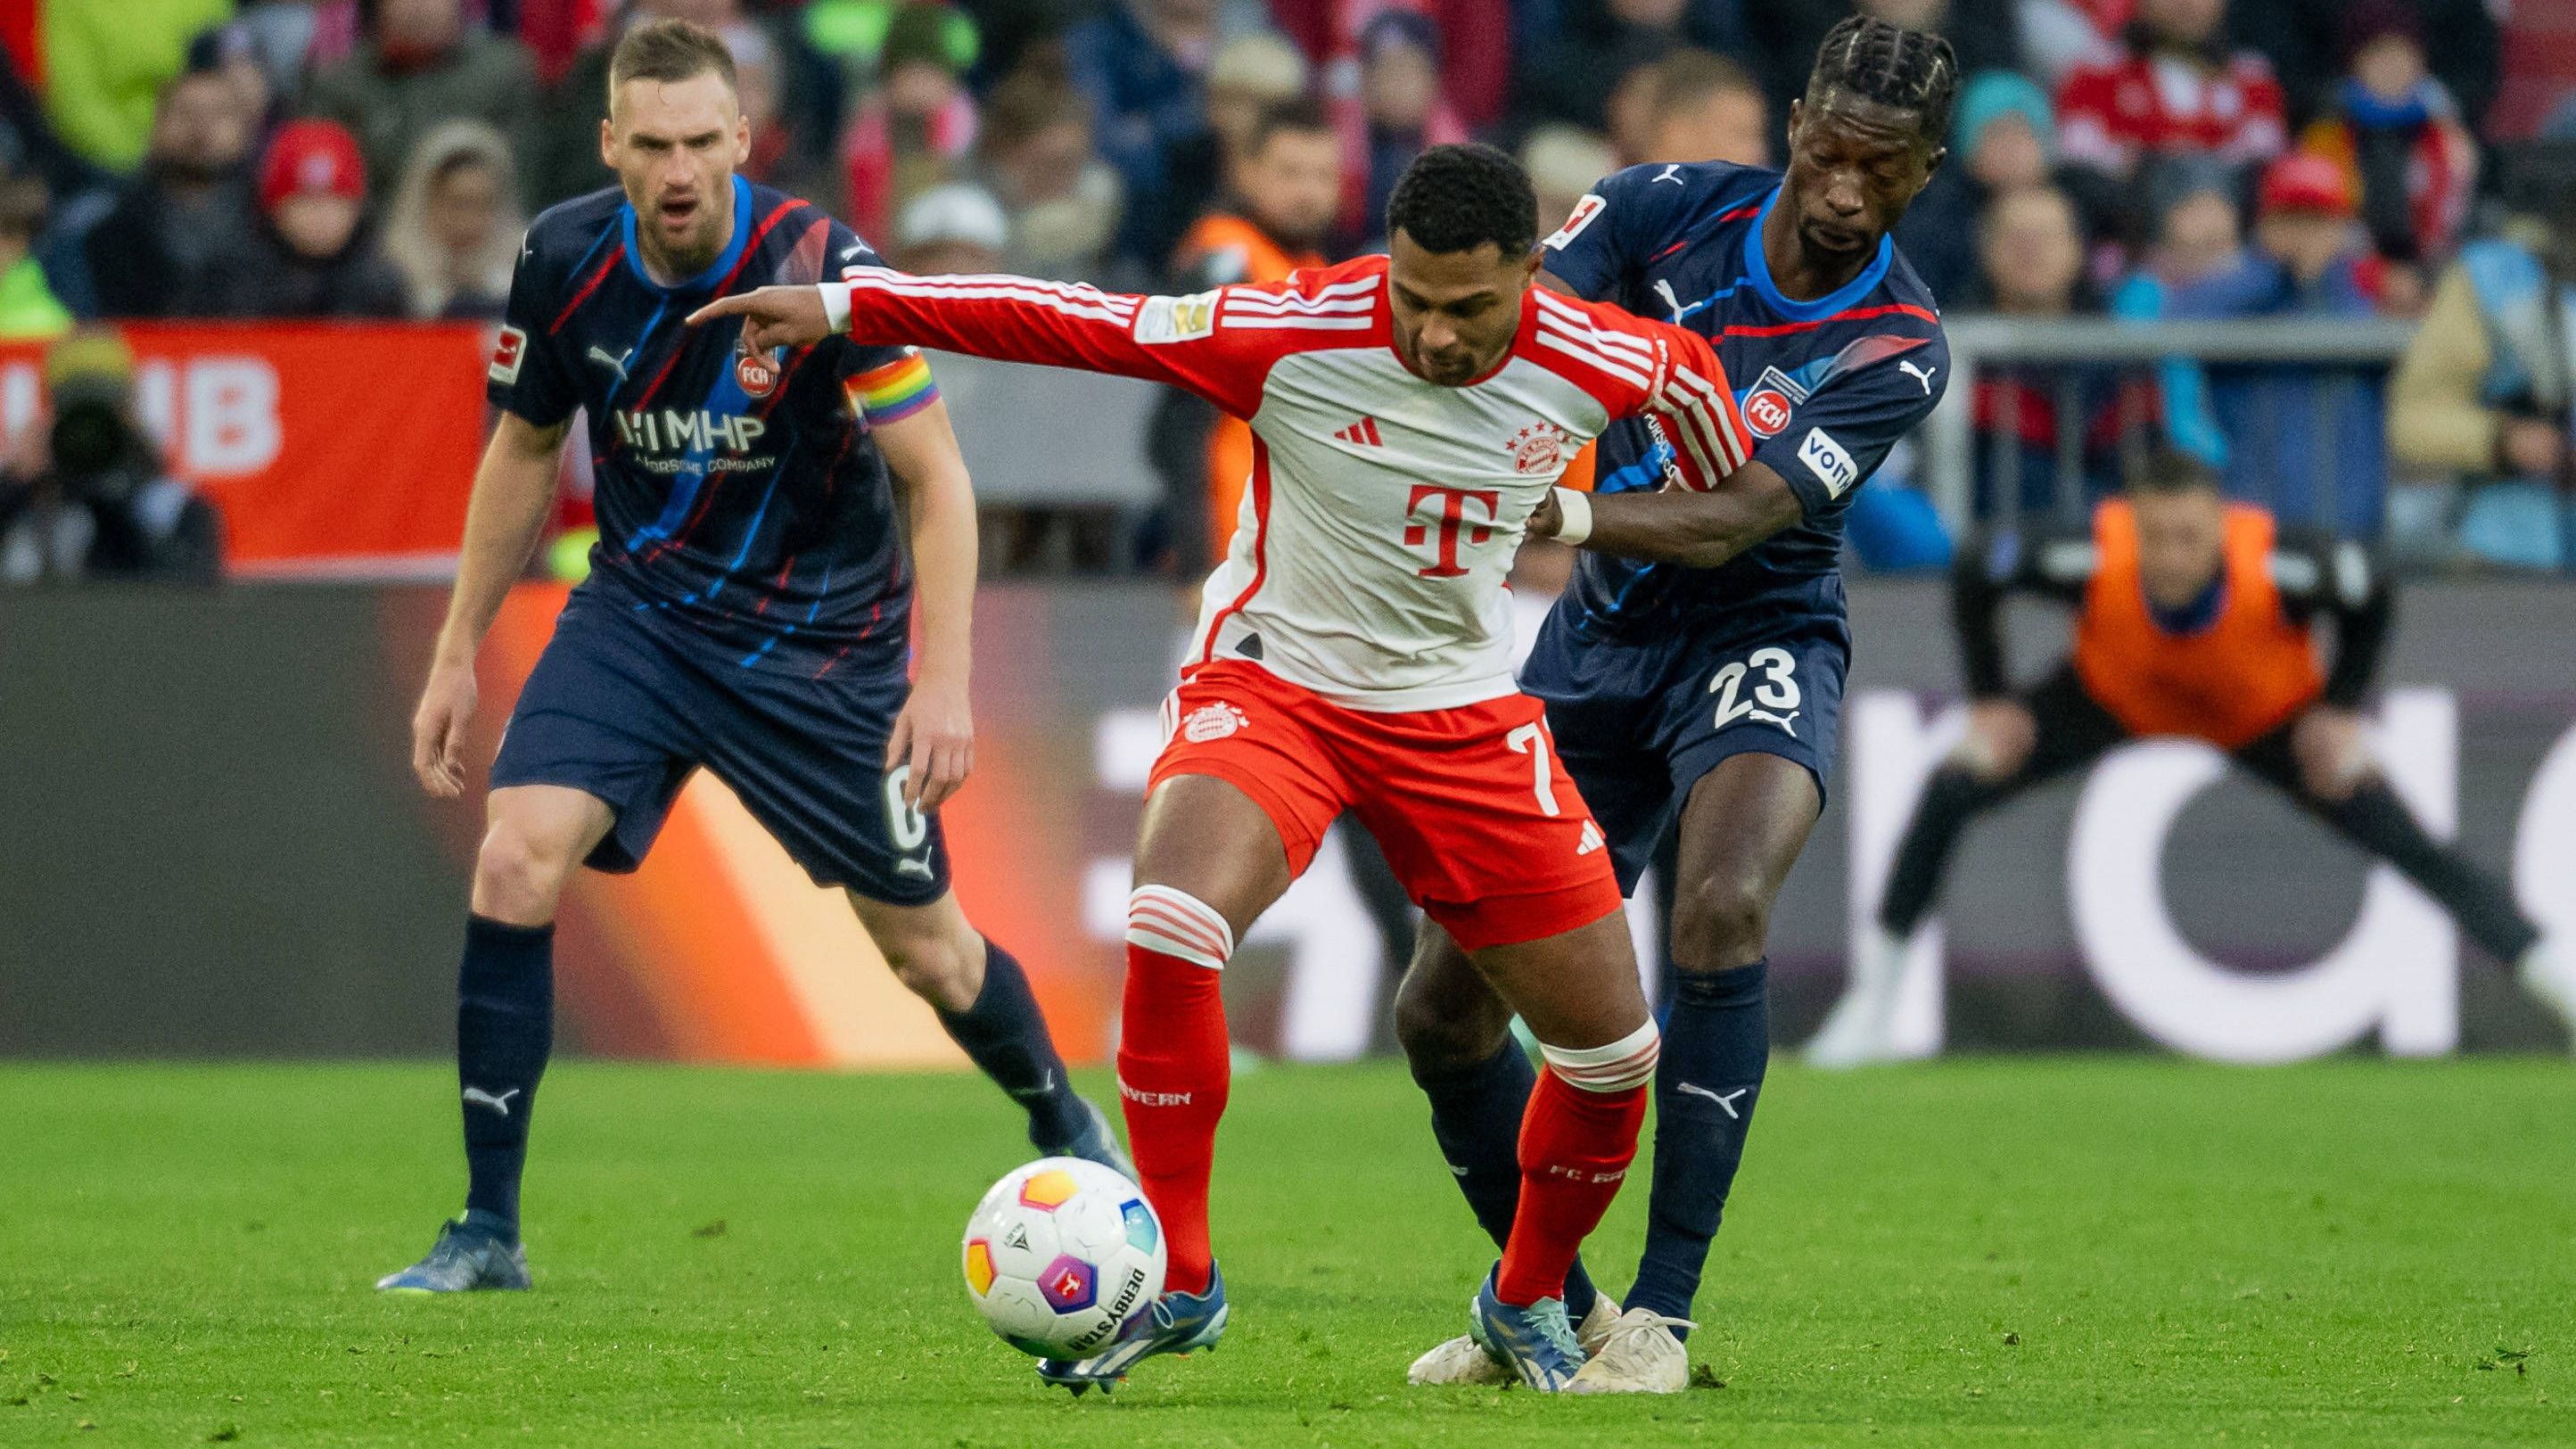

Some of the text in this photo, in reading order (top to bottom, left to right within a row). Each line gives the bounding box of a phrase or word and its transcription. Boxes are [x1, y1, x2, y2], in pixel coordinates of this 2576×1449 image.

[1750, 397, 1787, 429] FCH
[707, 456, 775, 473] COMPANY
[1809, 436, 1852, 491] VOITH
[1404, 484, 1501, 578] T
[1709, 647, 1802, 729] 23
[1506, 720, 1560, 817] 7
[1070, 1268, 1145, 1352] DERBYSTAR
